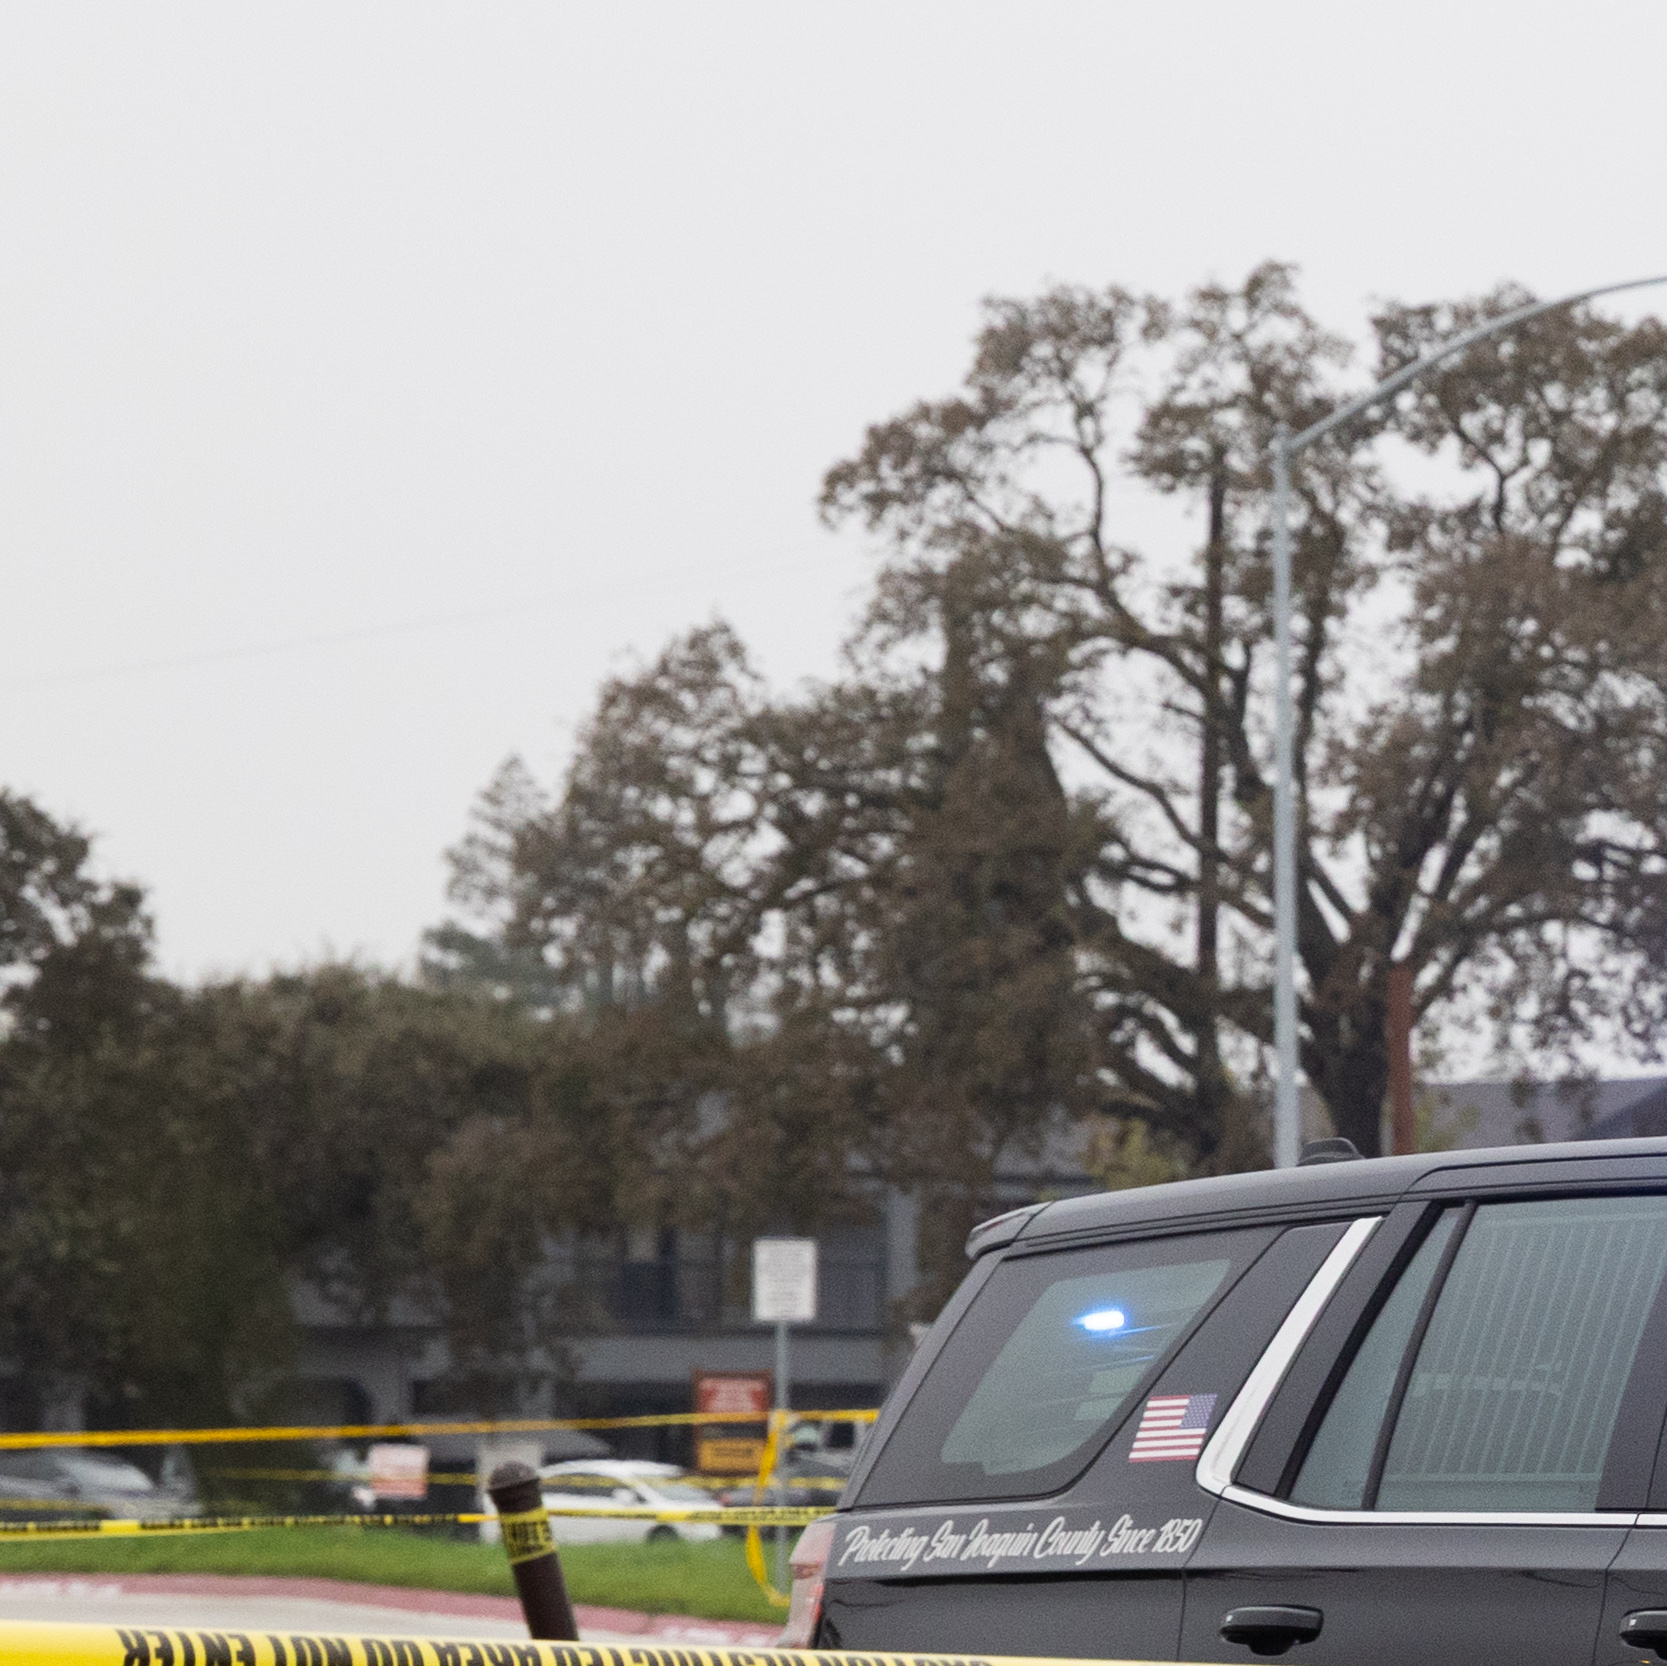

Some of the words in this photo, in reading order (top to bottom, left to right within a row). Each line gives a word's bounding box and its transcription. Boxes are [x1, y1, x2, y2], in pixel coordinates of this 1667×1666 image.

[838, 1525, 927, 1572] Protecting
[924, 1519, 965, 1563] San
[960, 1517, 1040, 1569] Joaquin
[1034, 1515, 1104, 1566] County
[1099, 1512, 1157, 1558] Since
[1150, 1516, 1203, 1554] 1850
